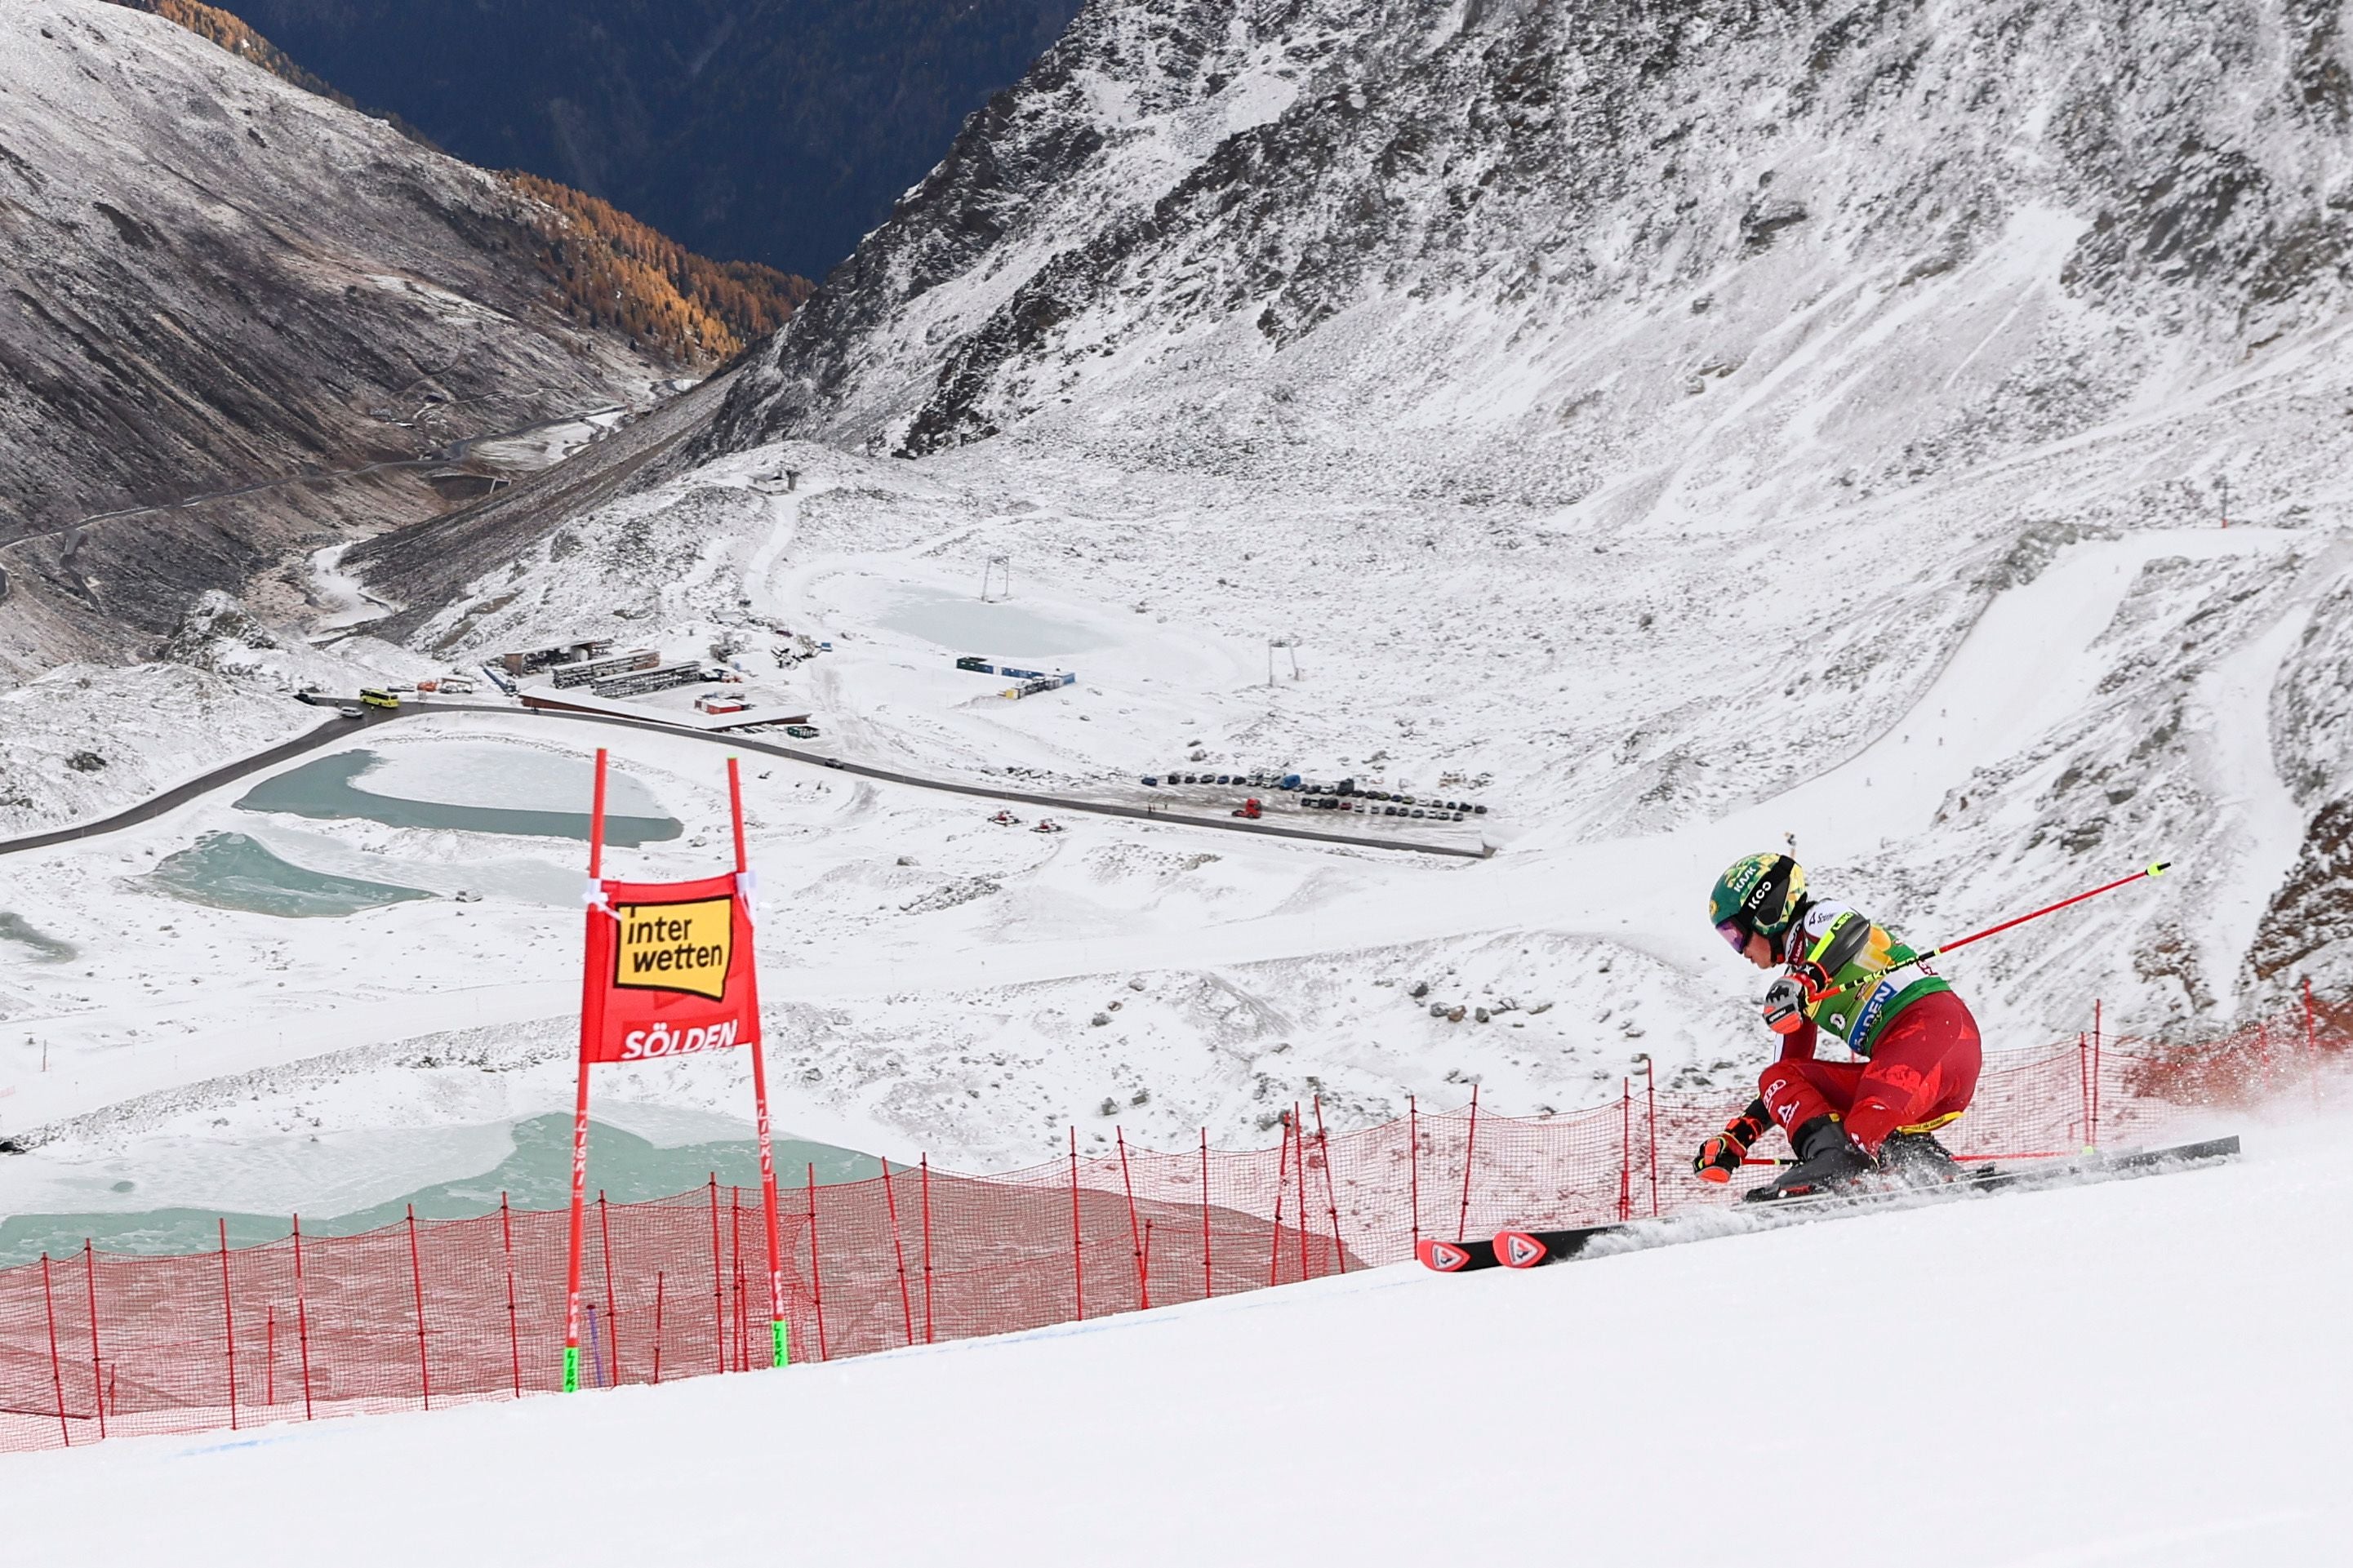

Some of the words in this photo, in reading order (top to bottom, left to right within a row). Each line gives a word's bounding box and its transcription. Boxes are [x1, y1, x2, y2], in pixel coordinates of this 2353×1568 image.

[627, 905, 692, 945] inter
[633, 943, 723, 973] wetten
[1854, 969, 1886, 986] LEKI
[621, 1019, 738, 1059] SÖLDEN
[573, 1119, 587, 1186] LISKI
[758, 1108, 772, 1170] LISKI
